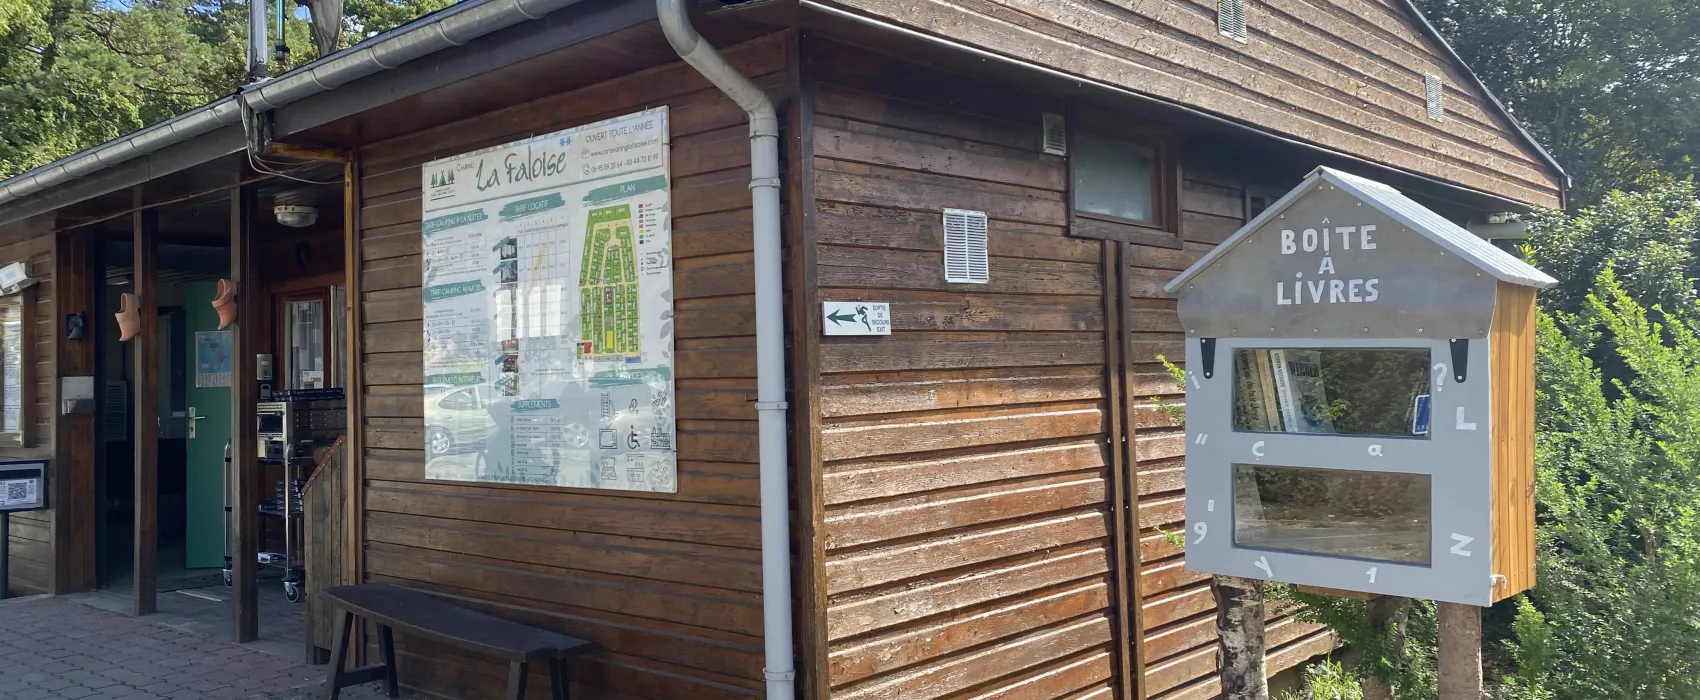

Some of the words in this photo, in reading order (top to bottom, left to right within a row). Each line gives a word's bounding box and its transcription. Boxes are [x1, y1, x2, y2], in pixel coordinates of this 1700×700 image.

[586, 131, 608, 144] OUVERT
[609, 126, 628, 138] TOUTE
[475, 158, 501, 192] La
[504, 144, 568, 185] Faloise
[620, 184, 636, 194] PLAN
[1281, 217, 1377, 255] BOÎTE
[1455, 406, 1477, 431] L
[1367, 444, 1383, 457] a
[1192, 521, 1208, 545] 9
[1365, 566, 1378, 584] 1
